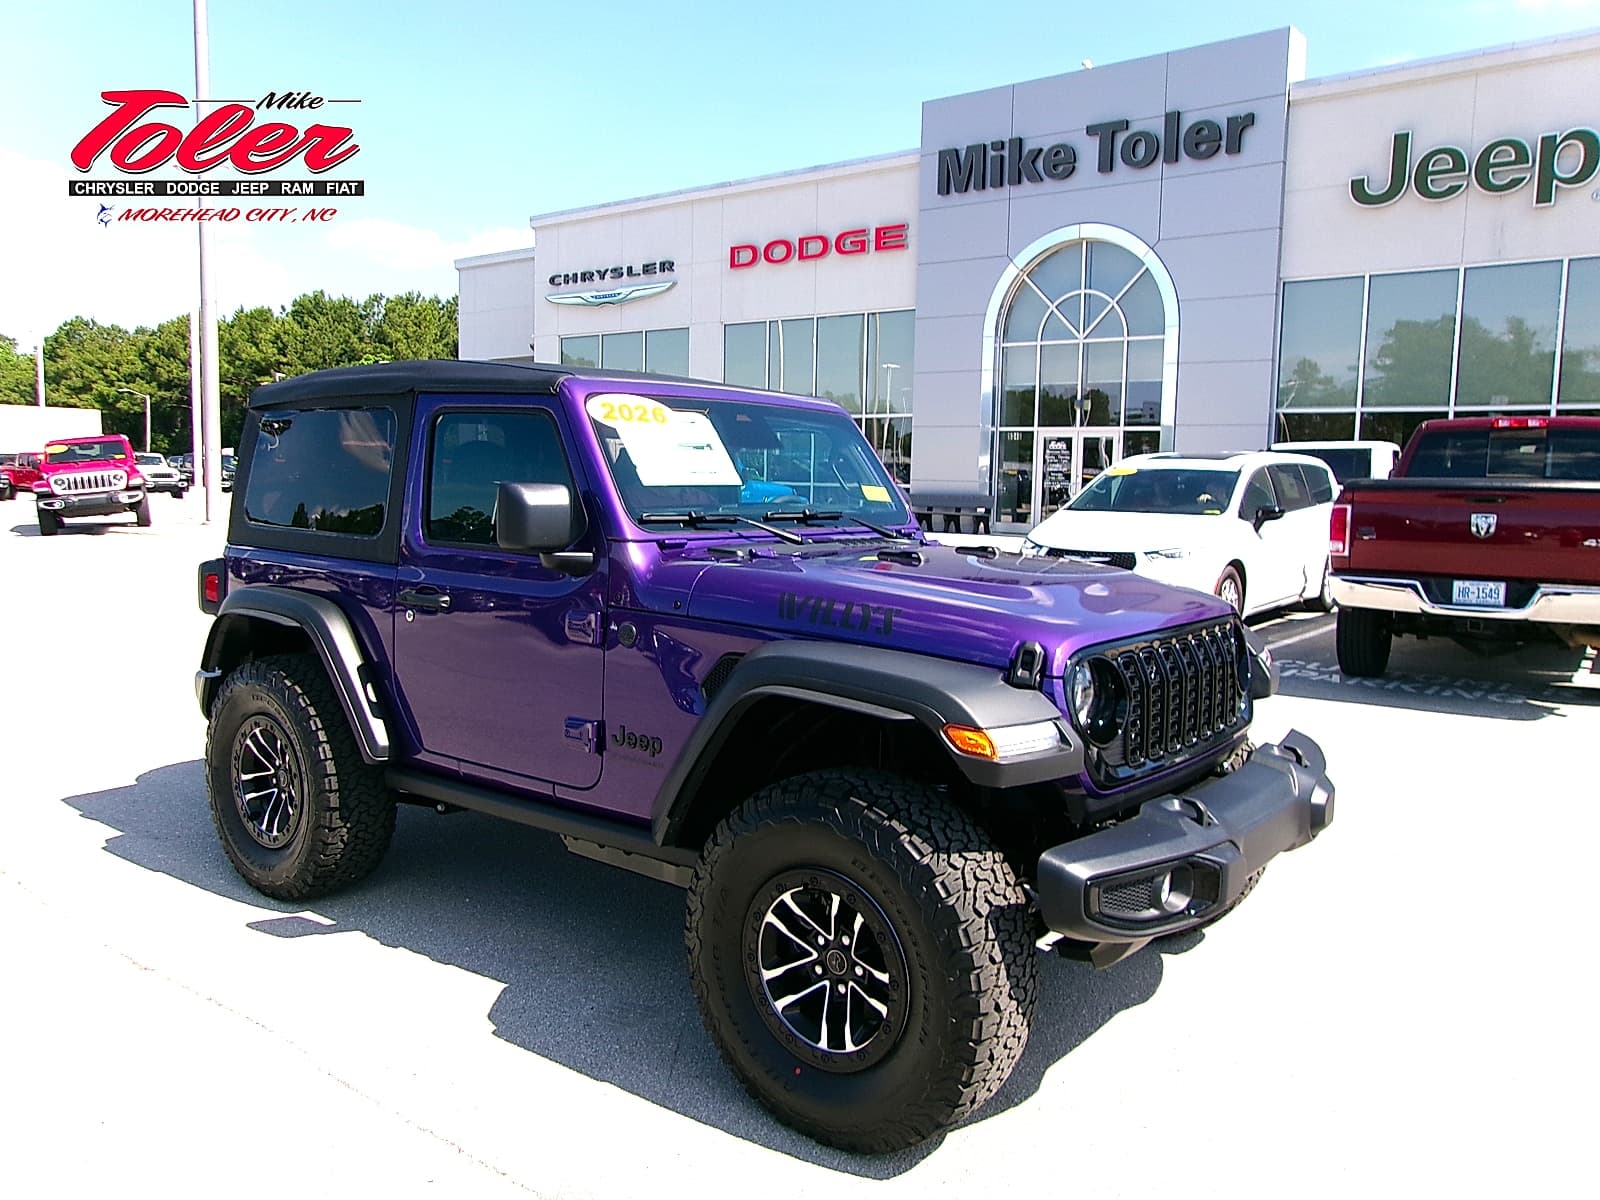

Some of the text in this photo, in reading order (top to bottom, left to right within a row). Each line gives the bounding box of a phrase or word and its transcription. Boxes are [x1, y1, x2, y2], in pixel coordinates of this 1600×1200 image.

[936, 110, 1255, 196] Mike Toler
[1348, 126, 1600, 208] Jeep
[729, 222, 908, 270] DODGE
[548, 259, 676, 287] CHRYSLER
[600, 400, 669, 426] 2026
[1457, 586, 1500, 600] HR-1549
[779, 592, 902, 636] WILLYS
[611, 724, 663, 759] Jeep
